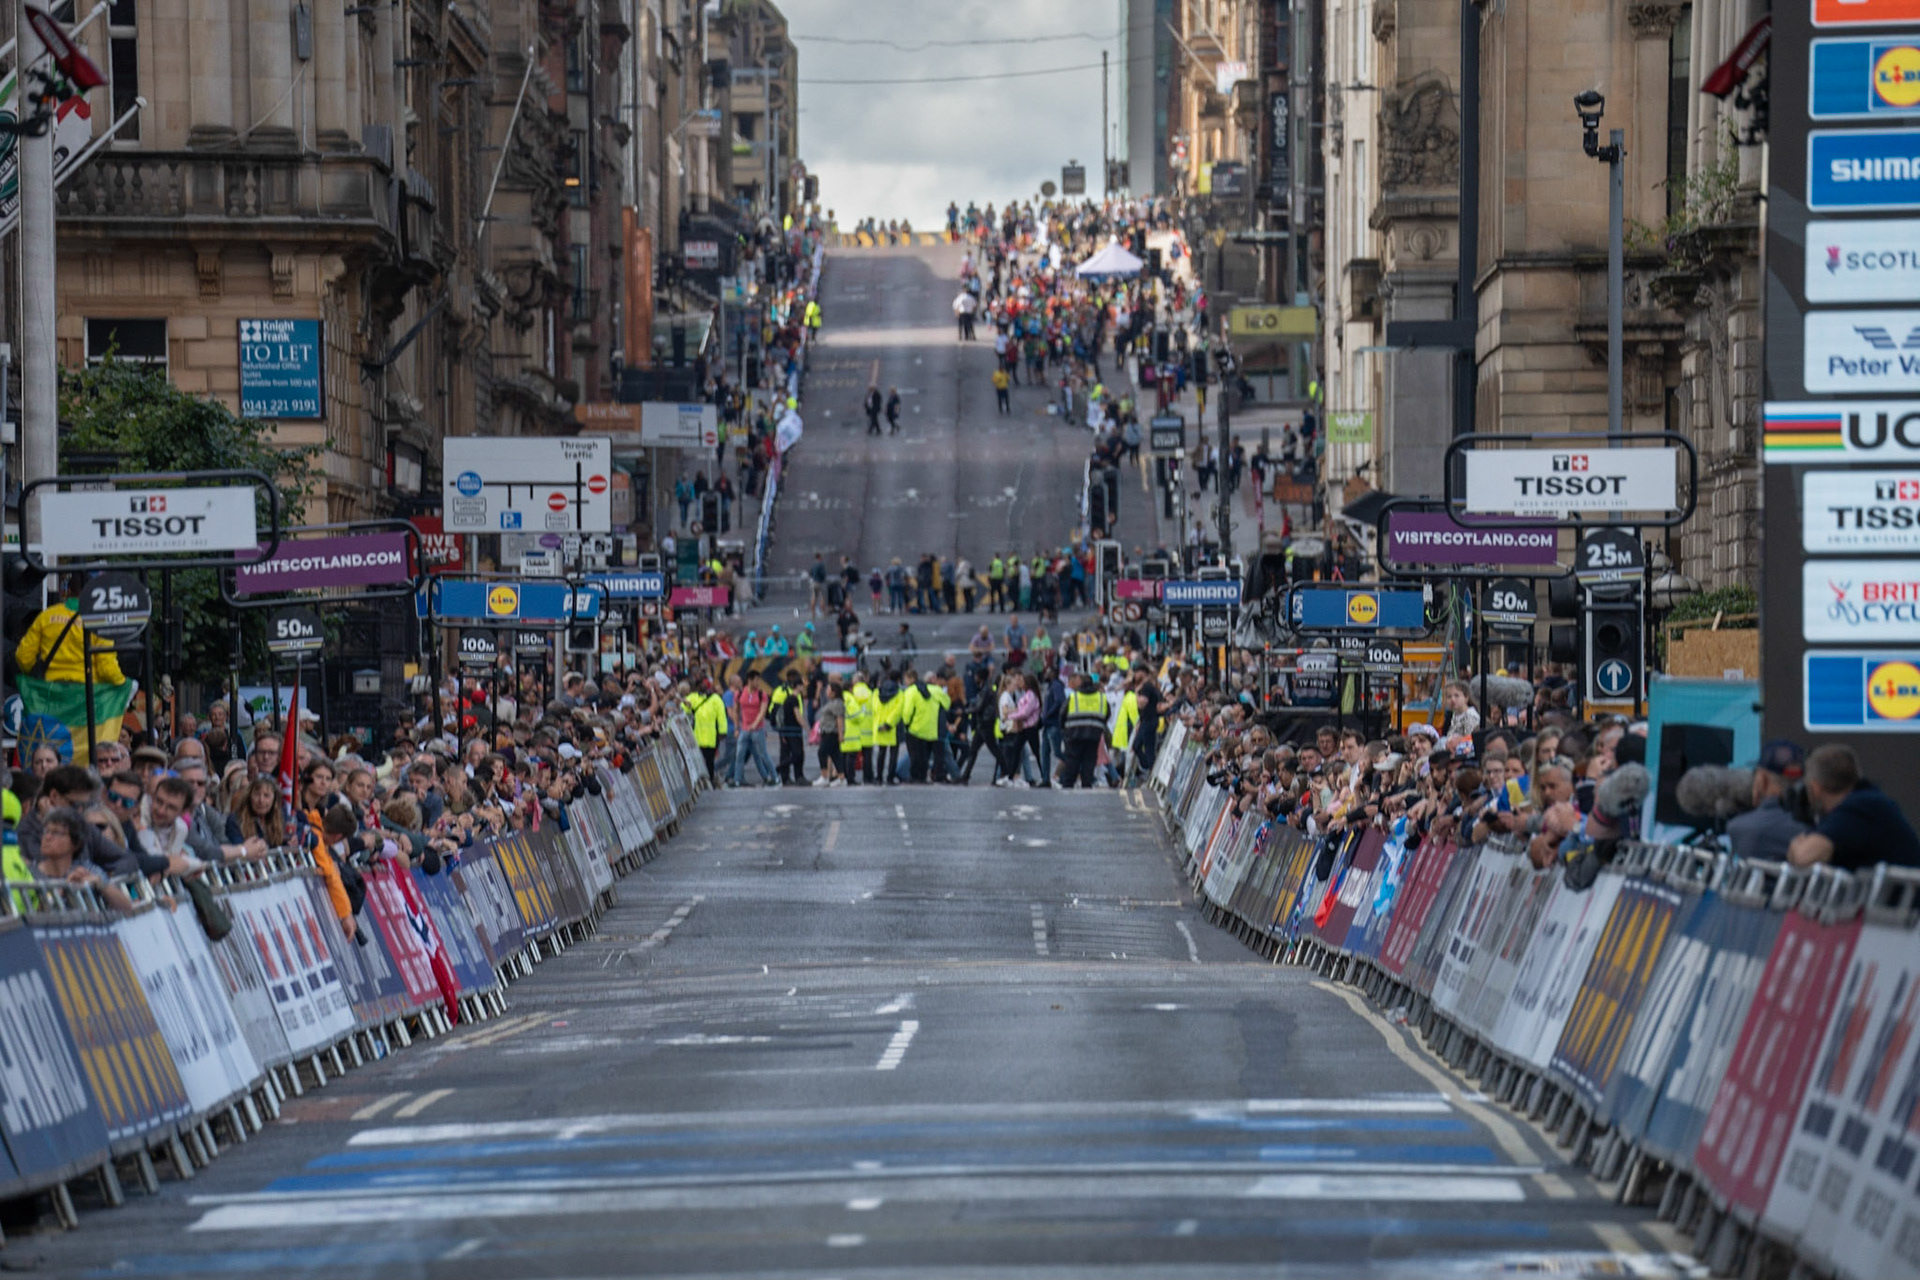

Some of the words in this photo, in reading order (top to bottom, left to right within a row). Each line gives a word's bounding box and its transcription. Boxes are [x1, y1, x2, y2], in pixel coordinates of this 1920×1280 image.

[263, 320, 295, 332] Knight
[263, 332, 290, 343] Frank
[241, 344, 271, 362] TO
[279, 344, 313, 362] LET
[1828, 355, 1891, 376] Peter
[242, 400, 267, 411] 0141
[270, 400, 289, 411] 221
[292, 399, 317, 412] 9191
[560, 440, 599, 451] Through
[564, 451, 594, 460] traffic
[1514, 476, 1627, 496] TISSOT
[1828, 506, 1920, 529] TISS
[92, 515, 206, 538] TISSOT
[421, 534, 456, 548] FIVE
[1395, 531, 1552, 547] VISITSCOTLAND.COM
[242, 551, 401, 575] VISITSCOTLAND.COM
[1587, 543, 1632, 567] 25M
[91, 586, 138, 611] 25M
[1166, 586, 1238, 600] SHIMANO
[1492, 592, 1528, 611] 50M
[277, 619, 314, 638] 50M
[462, 637, 495, 652] 100M
[1368, 648, 1400, 663] 100M
